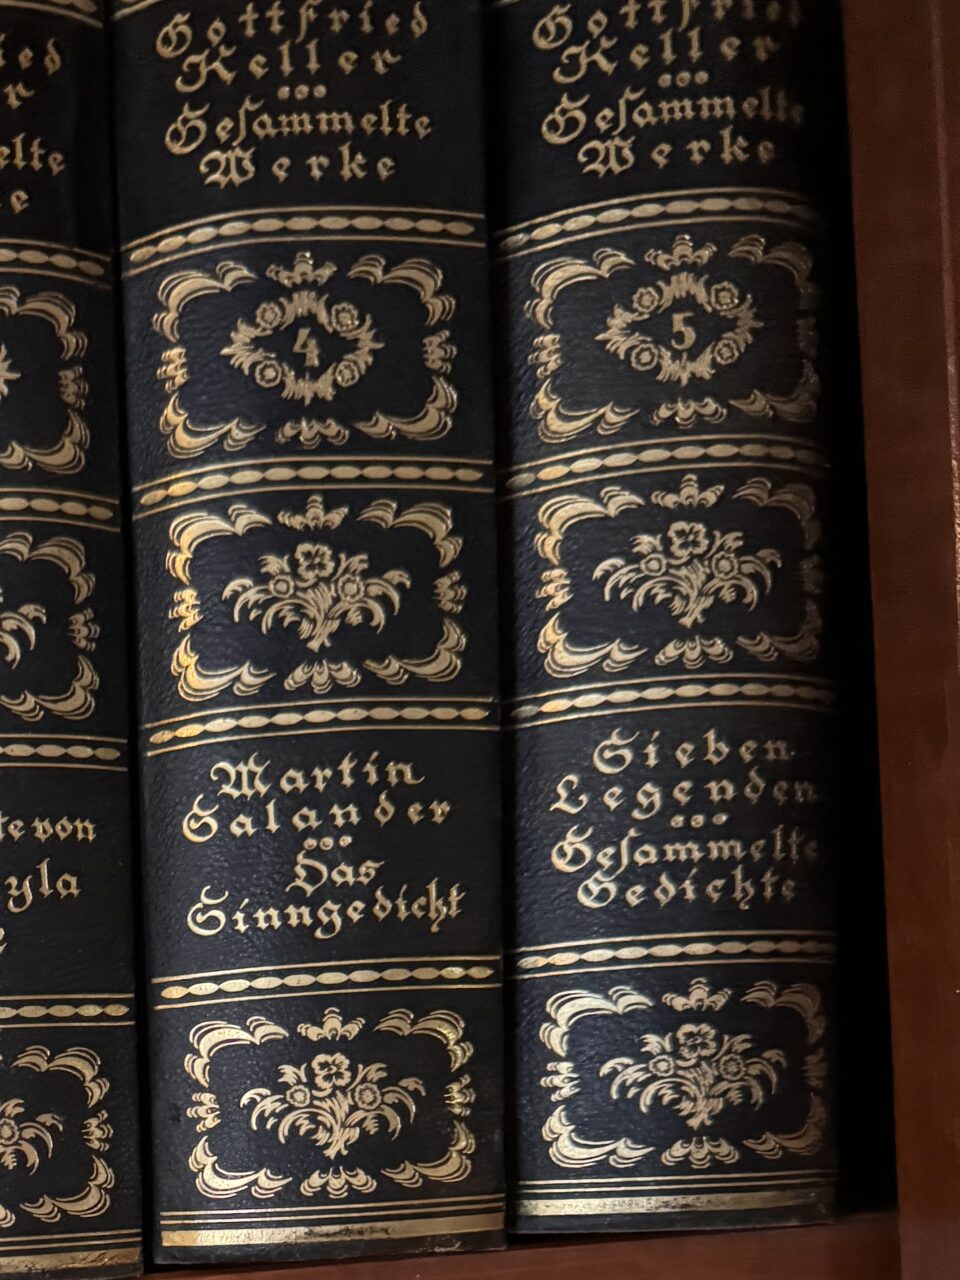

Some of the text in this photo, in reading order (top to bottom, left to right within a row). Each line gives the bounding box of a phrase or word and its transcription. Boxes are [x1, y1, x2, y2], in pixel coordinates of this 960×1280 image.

[155, 0, 428, 58] Gottfried
[175, 39, 401, 93] Keller
[553, 26, 781, 84] Keller
[199, 141, 397, 189] Werke
[577, 125, 775, 178] Werke
[292, 326, 321, 367] 4
[671, 311, 697, 350] 5
[210, 751, 425, 801] Martin
[592, 727, 791, 775] Sieben
[182, 789, 452, 843] Salander
[549, 765, 818, 820] Legenden
[31, 815, 97, 844] von
[285, 850, 385, 897] Das
[576, 865, 797, 910] Gedichte
[187, 877, 466, 940] Sinngedicht
